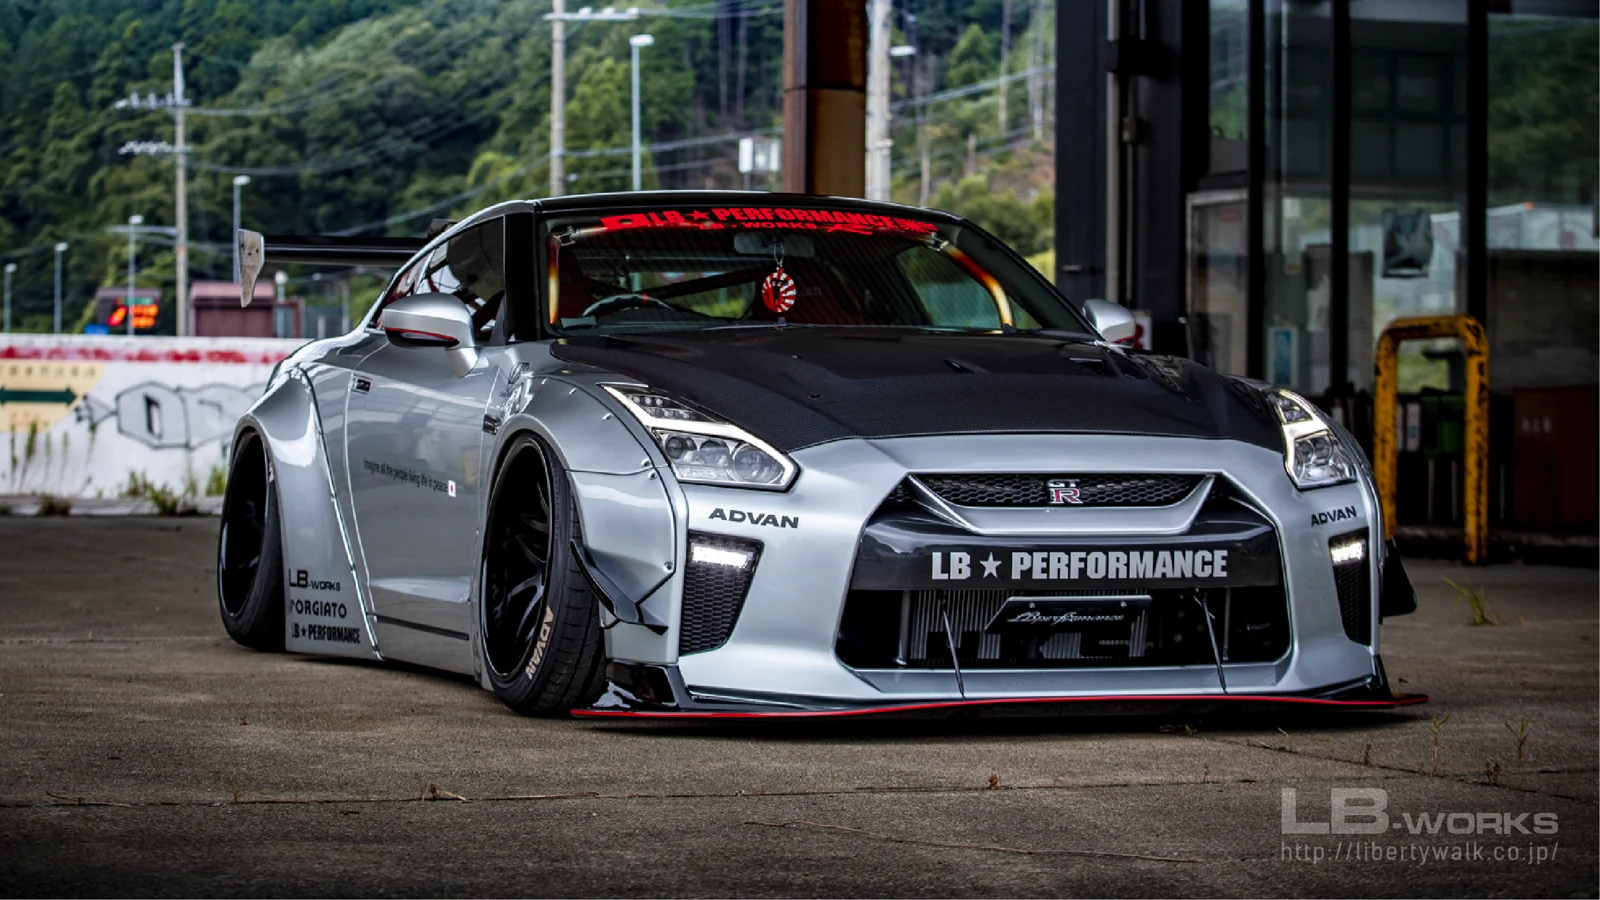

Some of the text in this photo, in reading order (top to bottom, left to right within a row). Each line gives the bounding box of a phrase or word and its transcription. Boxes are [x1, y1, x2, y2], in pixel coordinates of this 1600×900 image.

[648, 207, 898, 230] LB PERFORMANCE
[708, 508, 799, 529] ADVAN
[1311, 505, 1357, 526] ADVAN
[931, 550, 1228, 580] LB PERFORMANCE
[308, 624, 361, 644] PERFORMANCE
[525, 605, 554, 680] ADVAN
